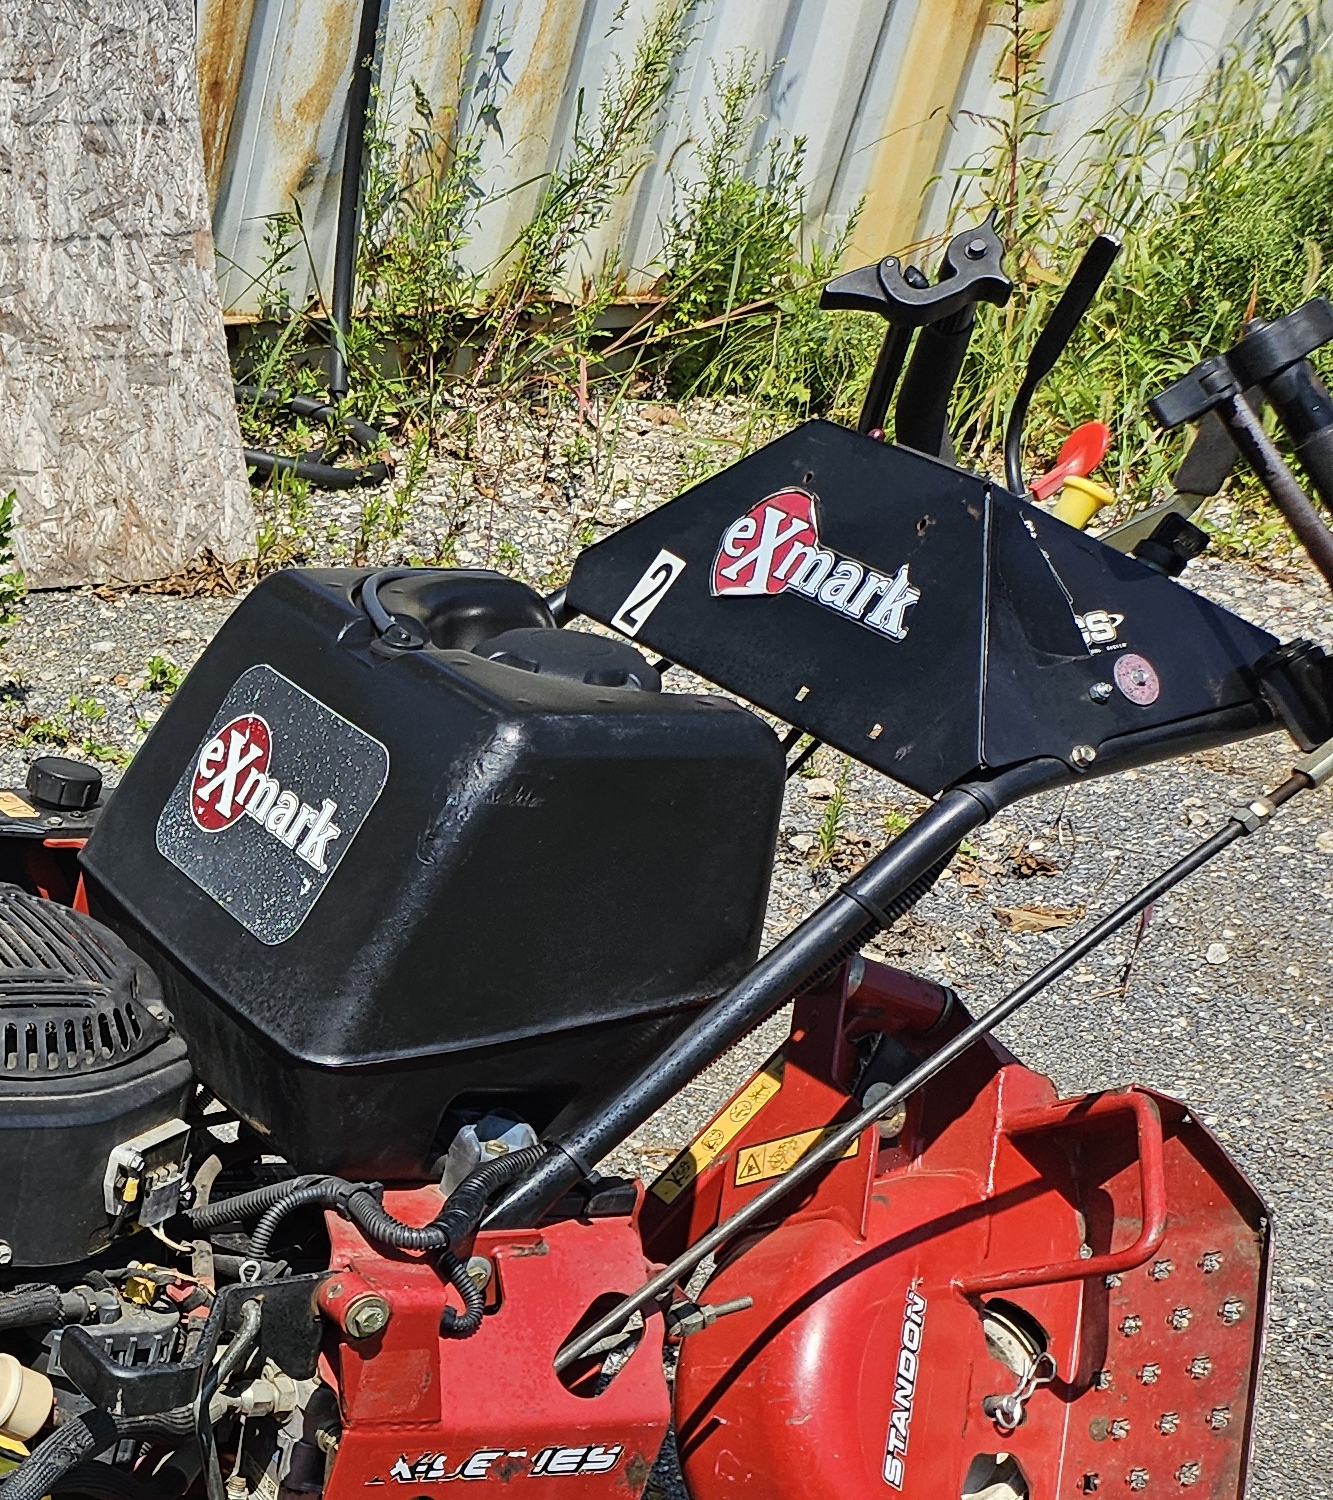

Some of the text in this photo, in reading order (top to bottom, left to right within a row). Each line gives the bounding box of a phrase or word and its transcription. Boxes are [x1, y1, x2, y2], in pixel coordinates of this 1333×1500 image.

[618, 563, 674, 629] 2
[719, 505, 921, 638] eXmark
[195, 728, 342, 873] eXmark
